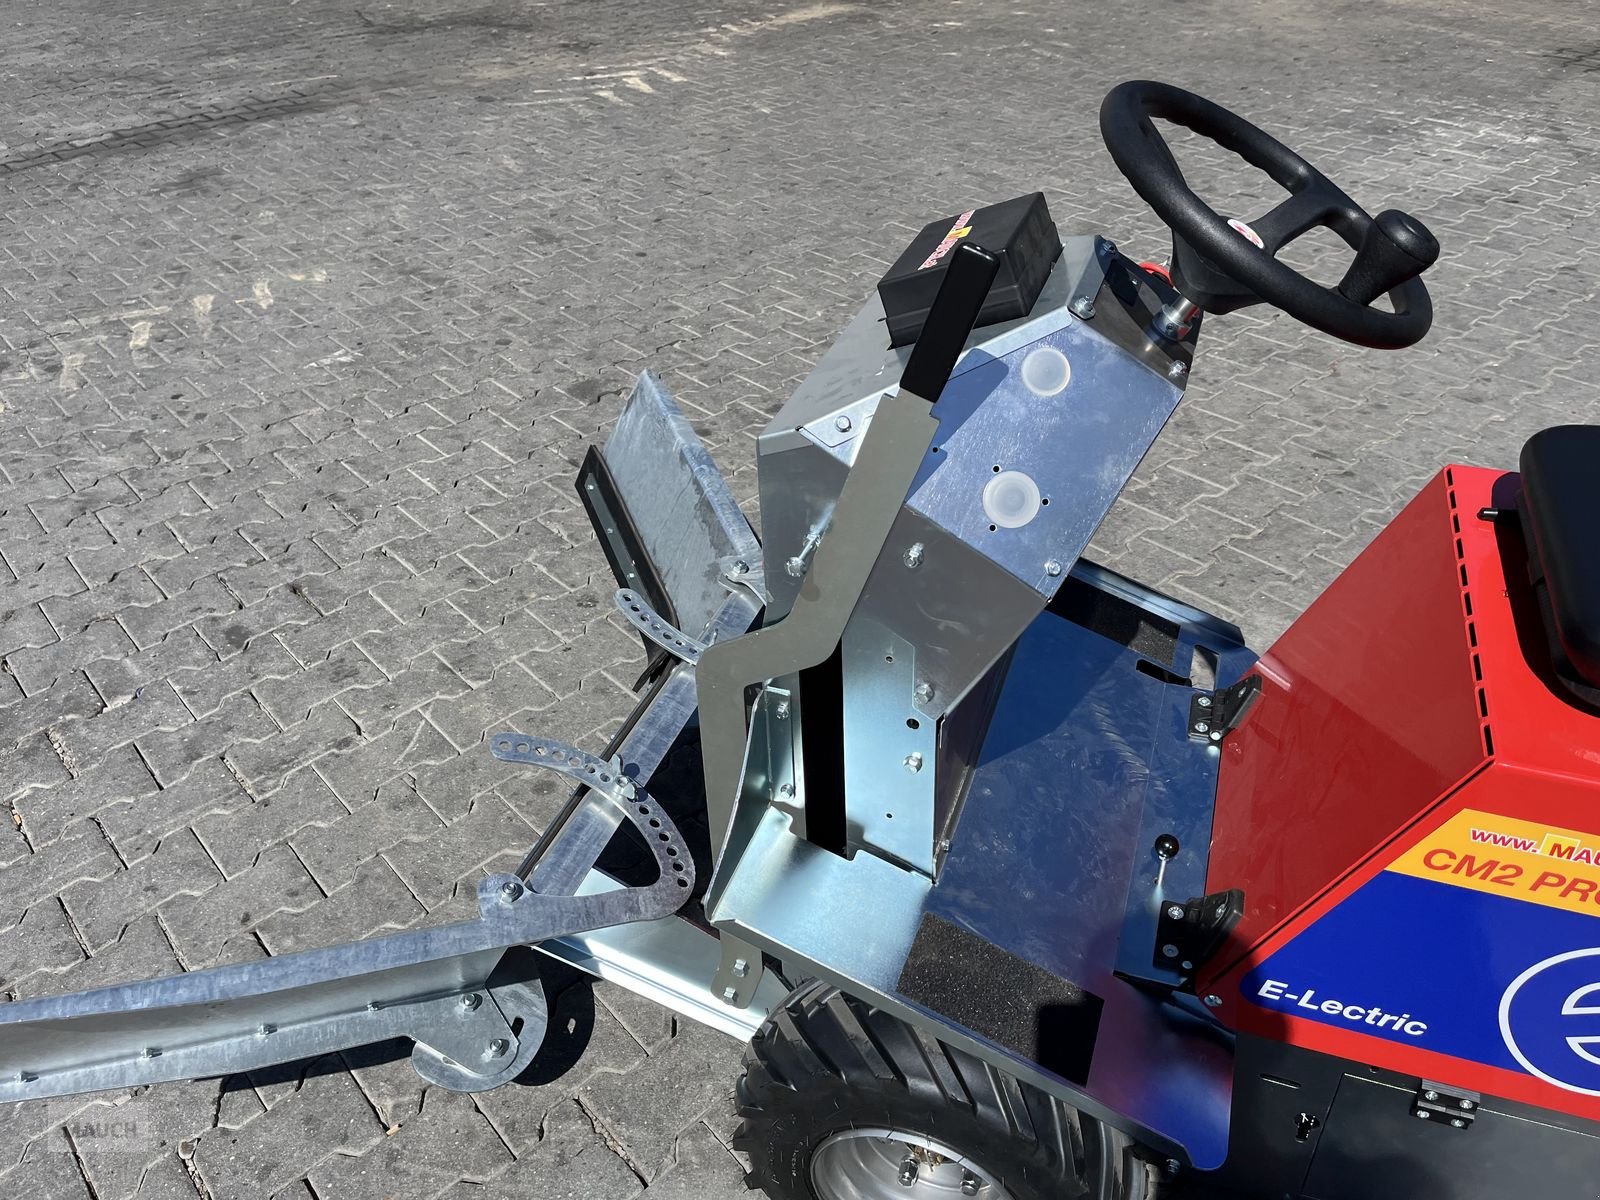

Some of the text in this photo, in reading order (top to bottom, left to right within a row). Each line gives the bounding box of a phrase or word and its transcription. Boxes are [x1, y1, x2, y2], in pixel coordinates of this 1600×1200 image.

[1423, 848, 1600, 906] CM2 PR
[1257, 979, 1428, 1036] E-Lectric
